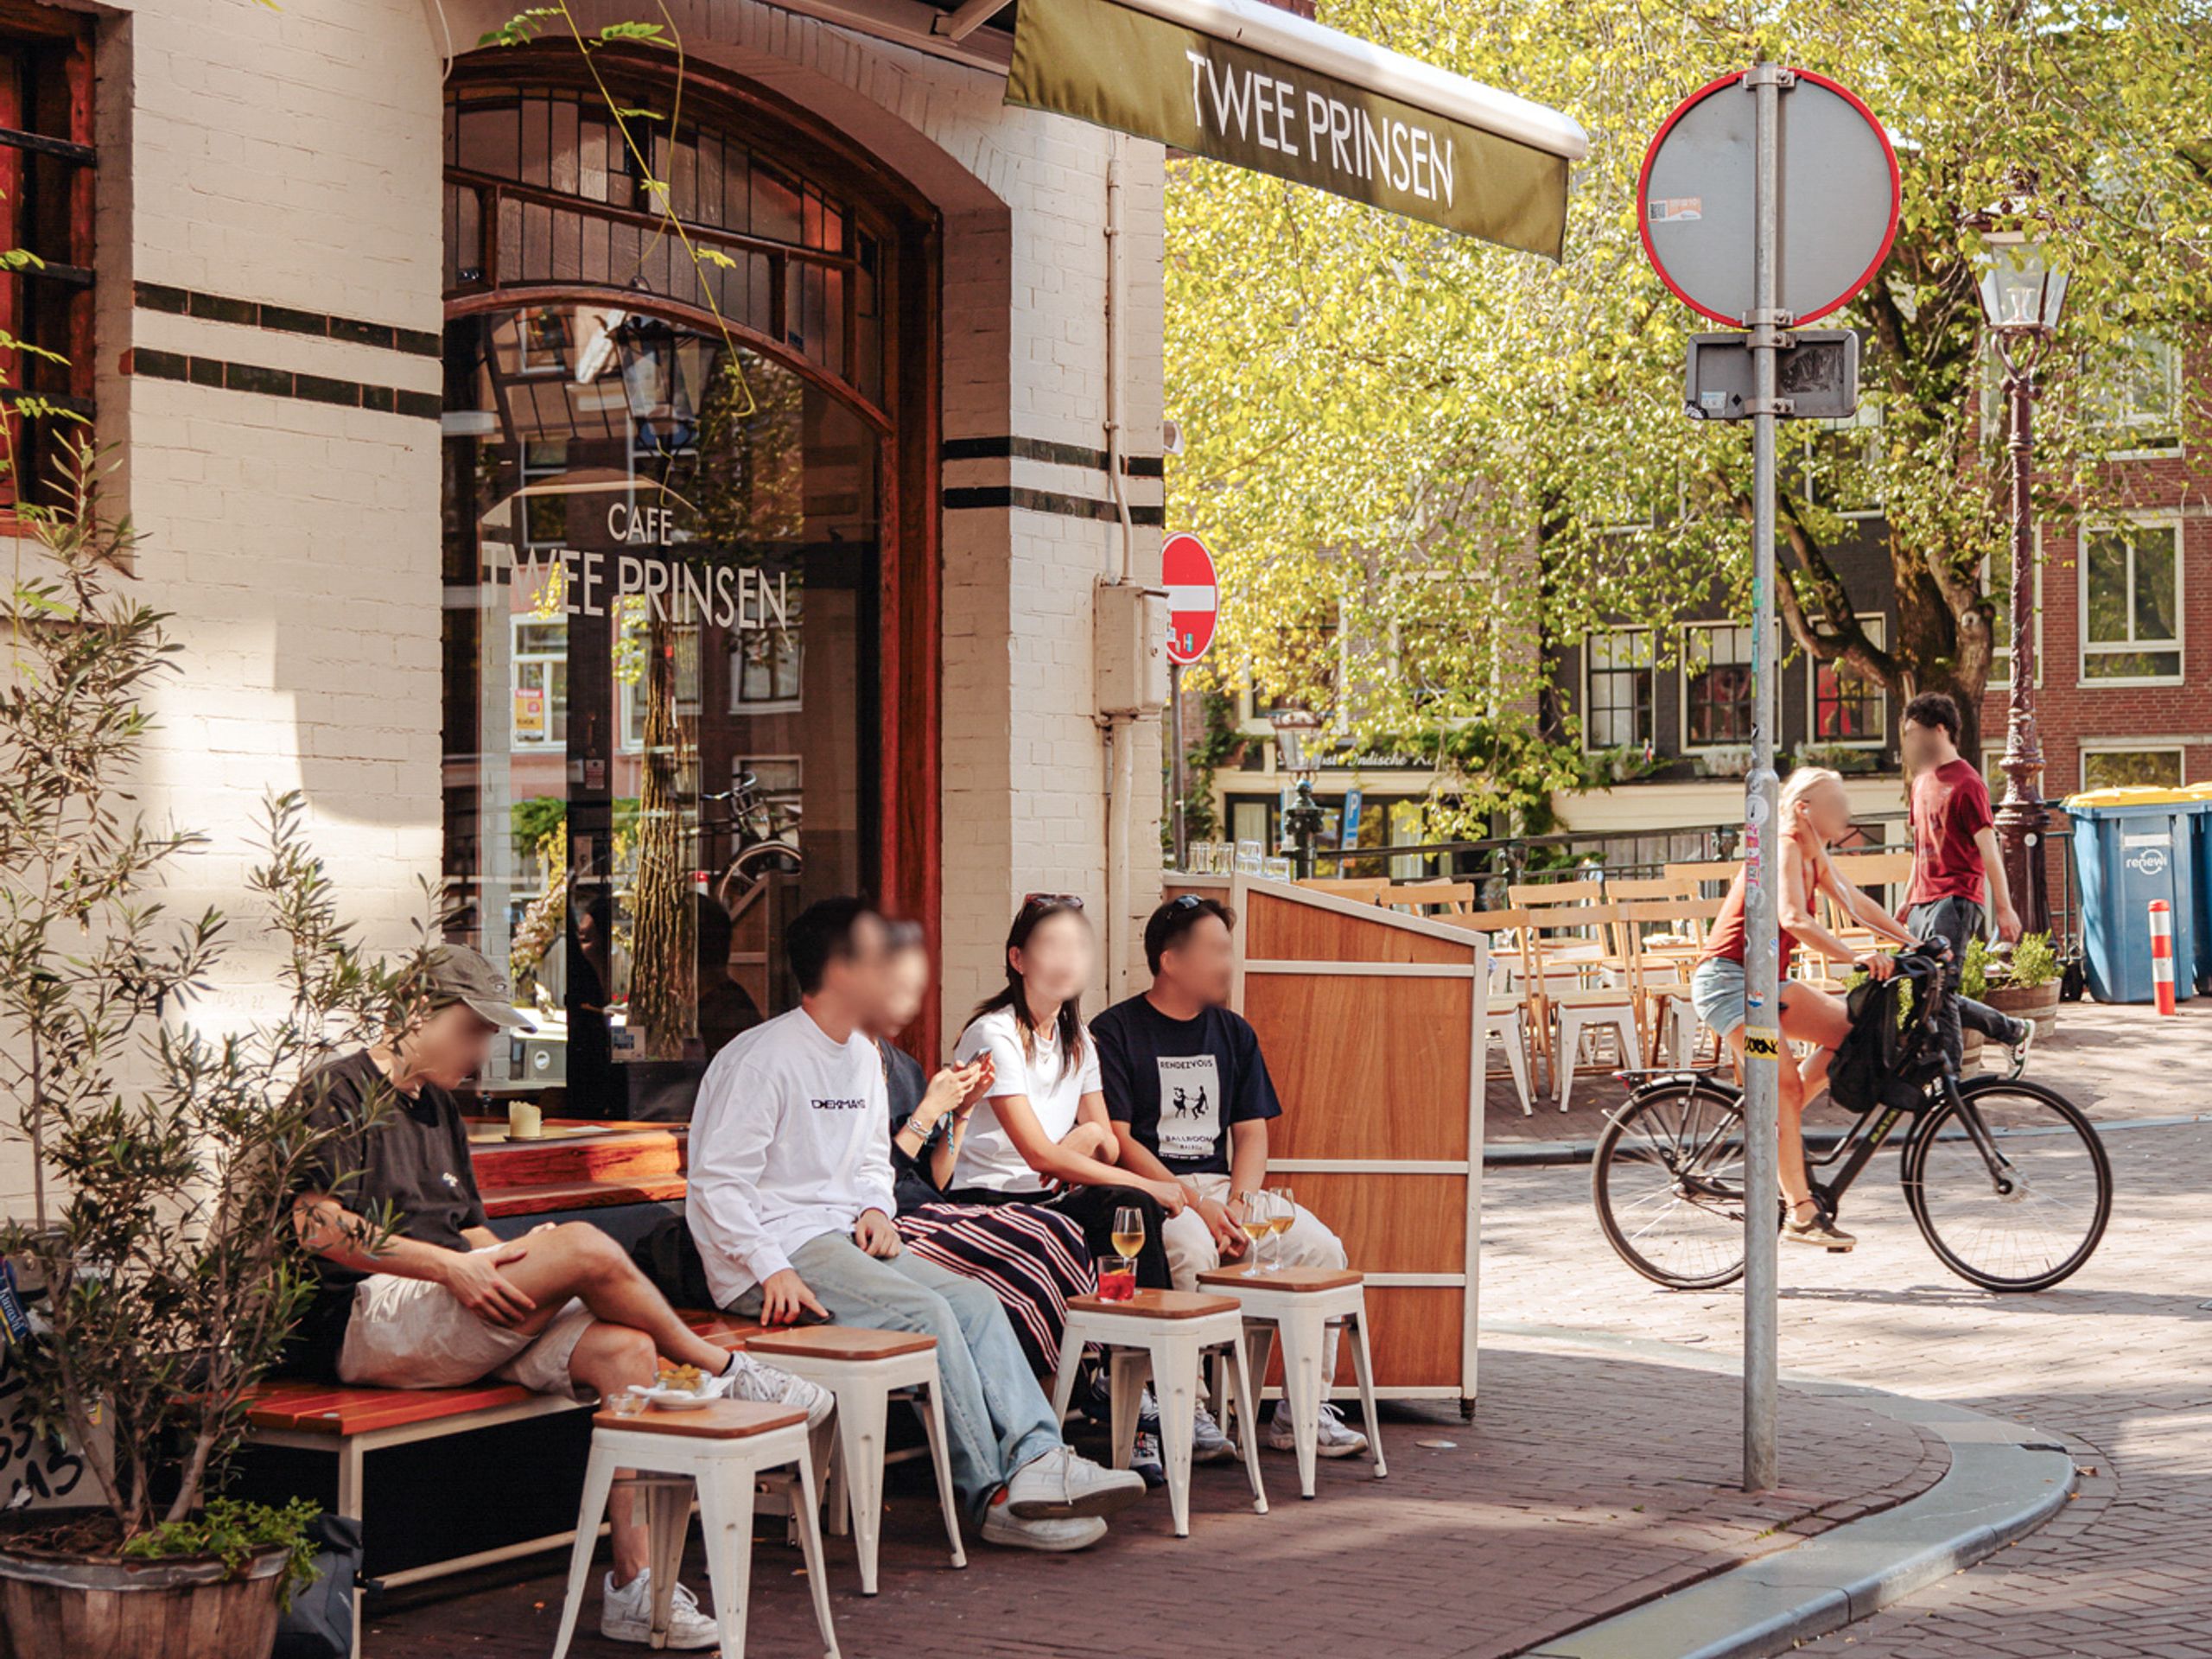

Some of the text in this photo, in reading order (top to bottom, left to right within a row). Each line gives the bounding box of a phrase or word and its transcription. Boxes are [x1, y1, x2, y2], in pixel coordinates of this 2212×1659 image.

[1185, 49, 1454, 209] TWEE PRINSEN
[607, 502, 673, 546] CAFE
[618, 556, 786, 631] PRINSEN
[1348, 792, 1358, 819] P
[2126, 855, 2167, 868] renewi
[1160, 1059, 1213, 1070] RENDEZVOUS
